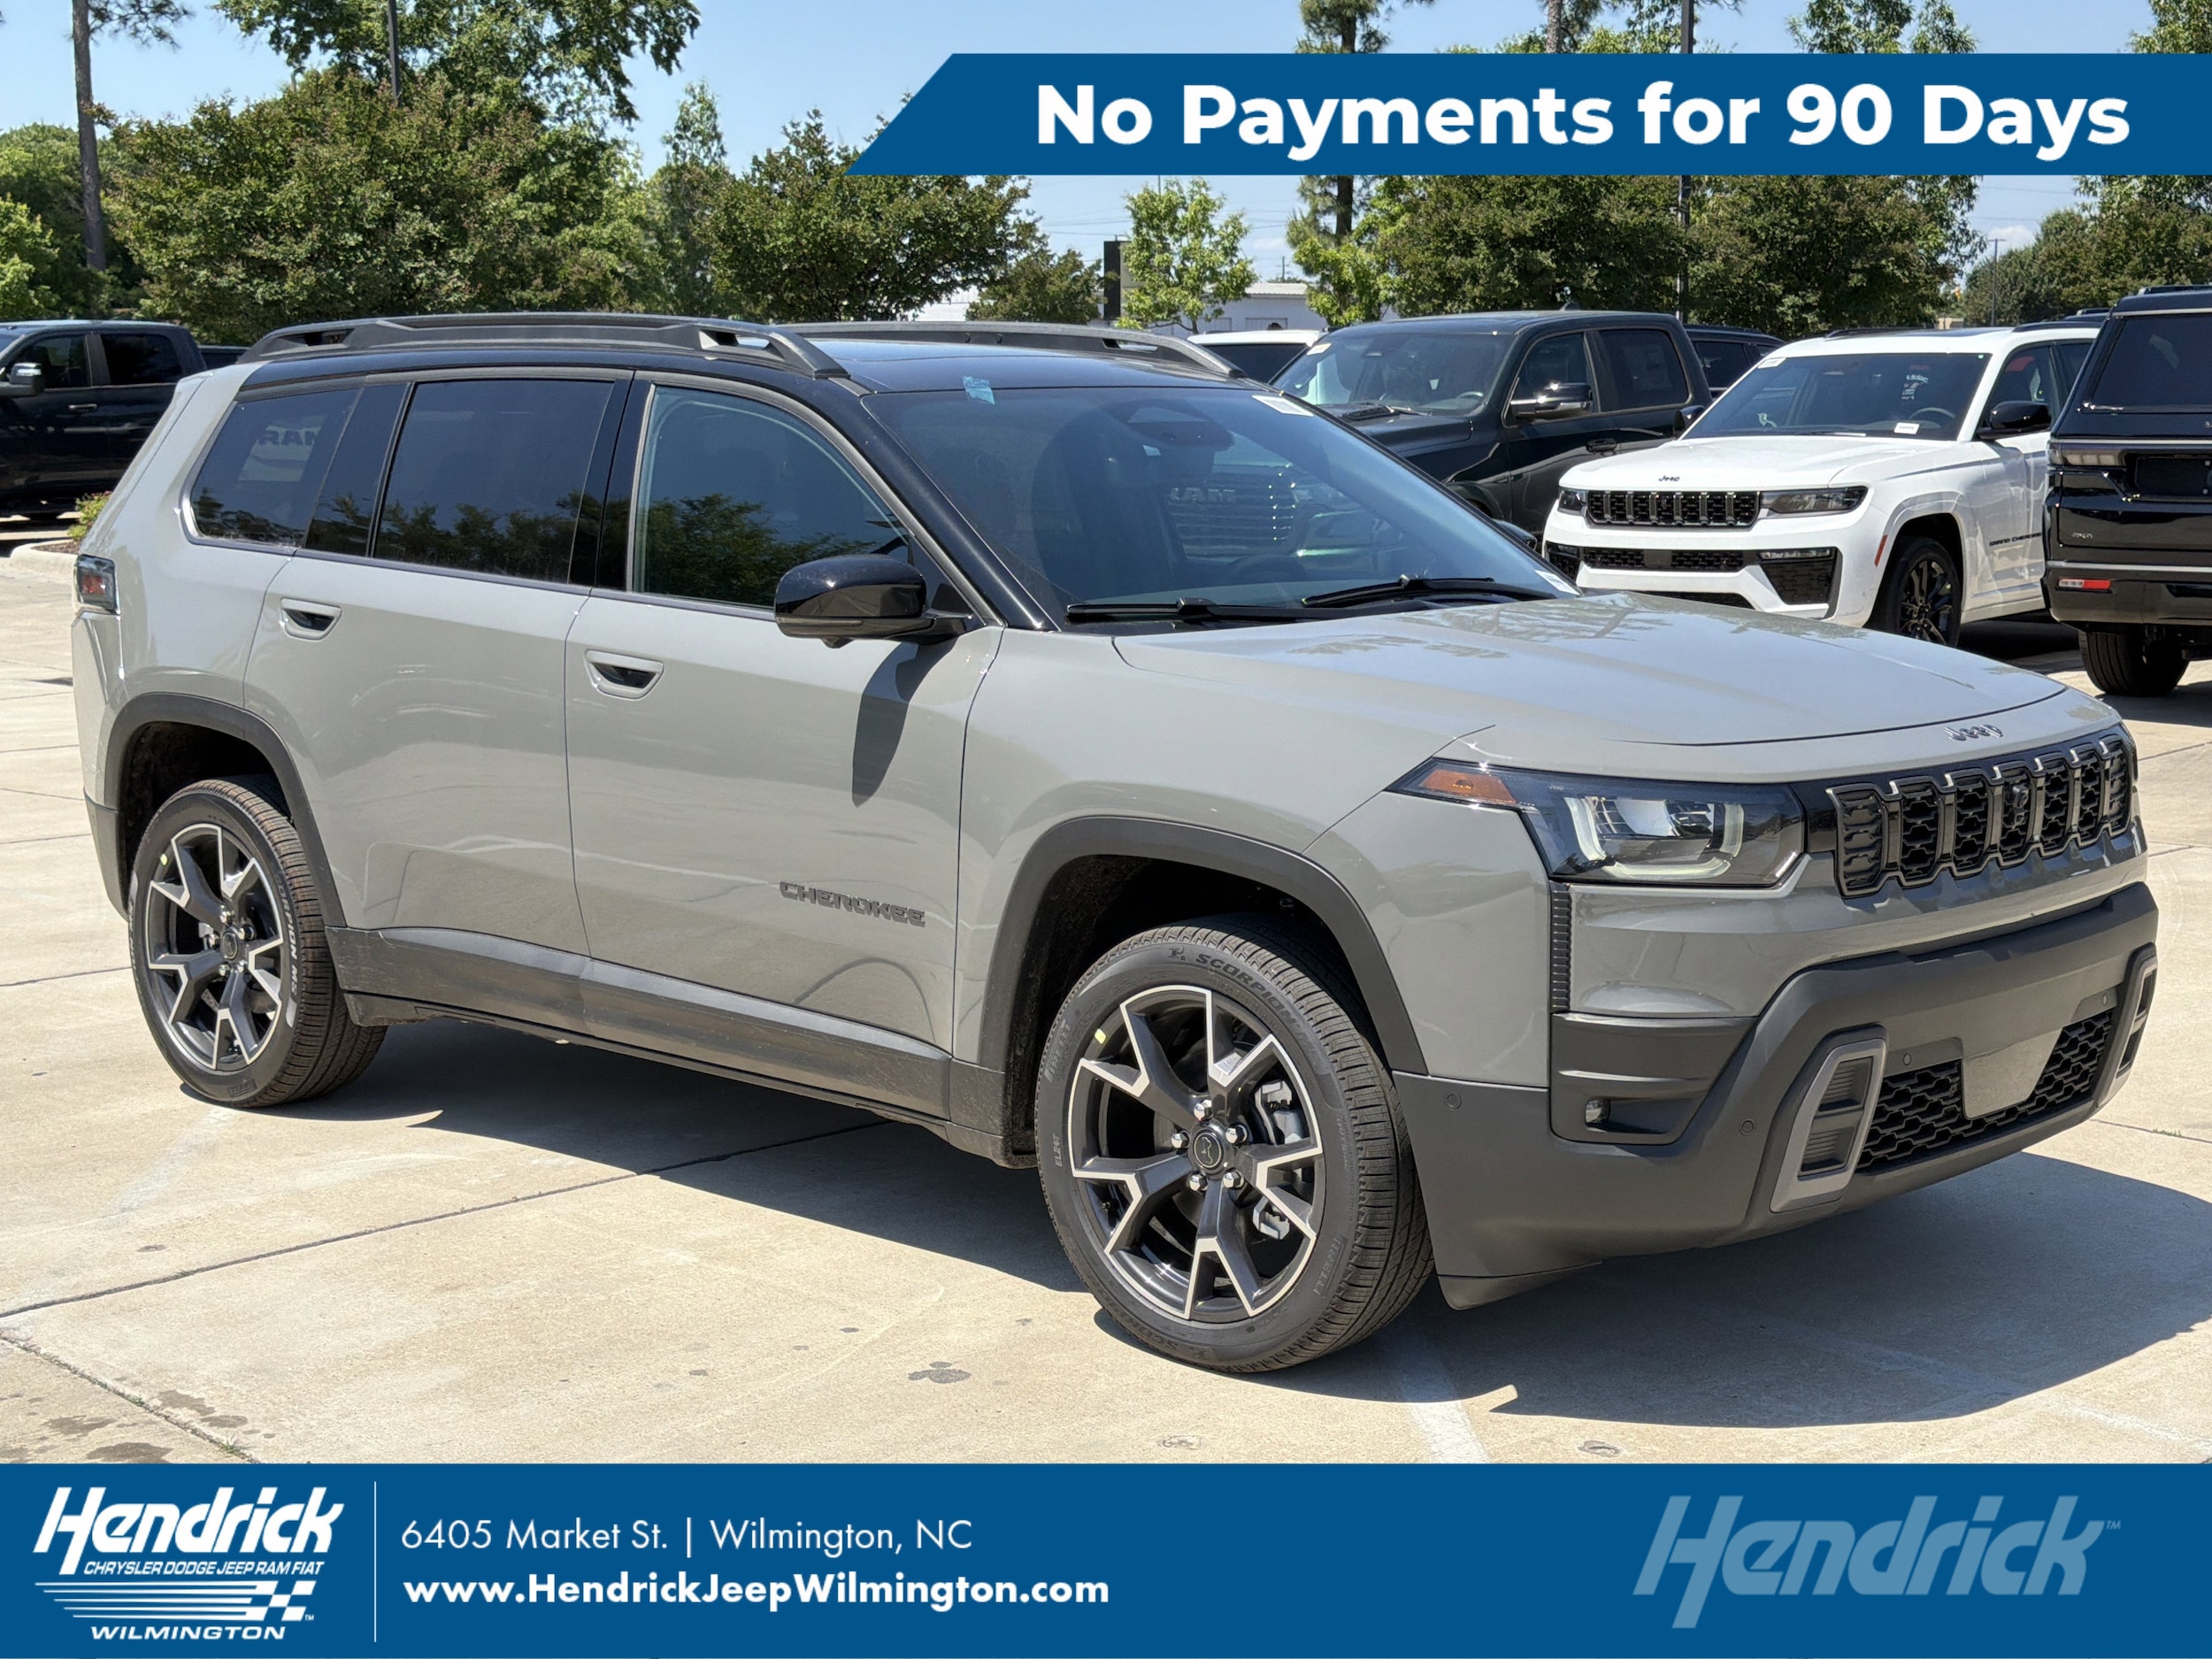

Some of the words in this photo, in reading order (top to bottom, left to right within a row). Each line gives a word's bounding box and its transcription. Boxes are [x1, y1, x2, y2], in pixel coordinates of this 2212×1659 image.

[1658, 473, 1680, 482] Jeep
[1943, 724, 2004, 741] Jeep
[273, 865, 298, 961] CORPION
[780, 881, 926, 927] CHEROKEE
[1195, 953, 1300, 1028] SCORPION
